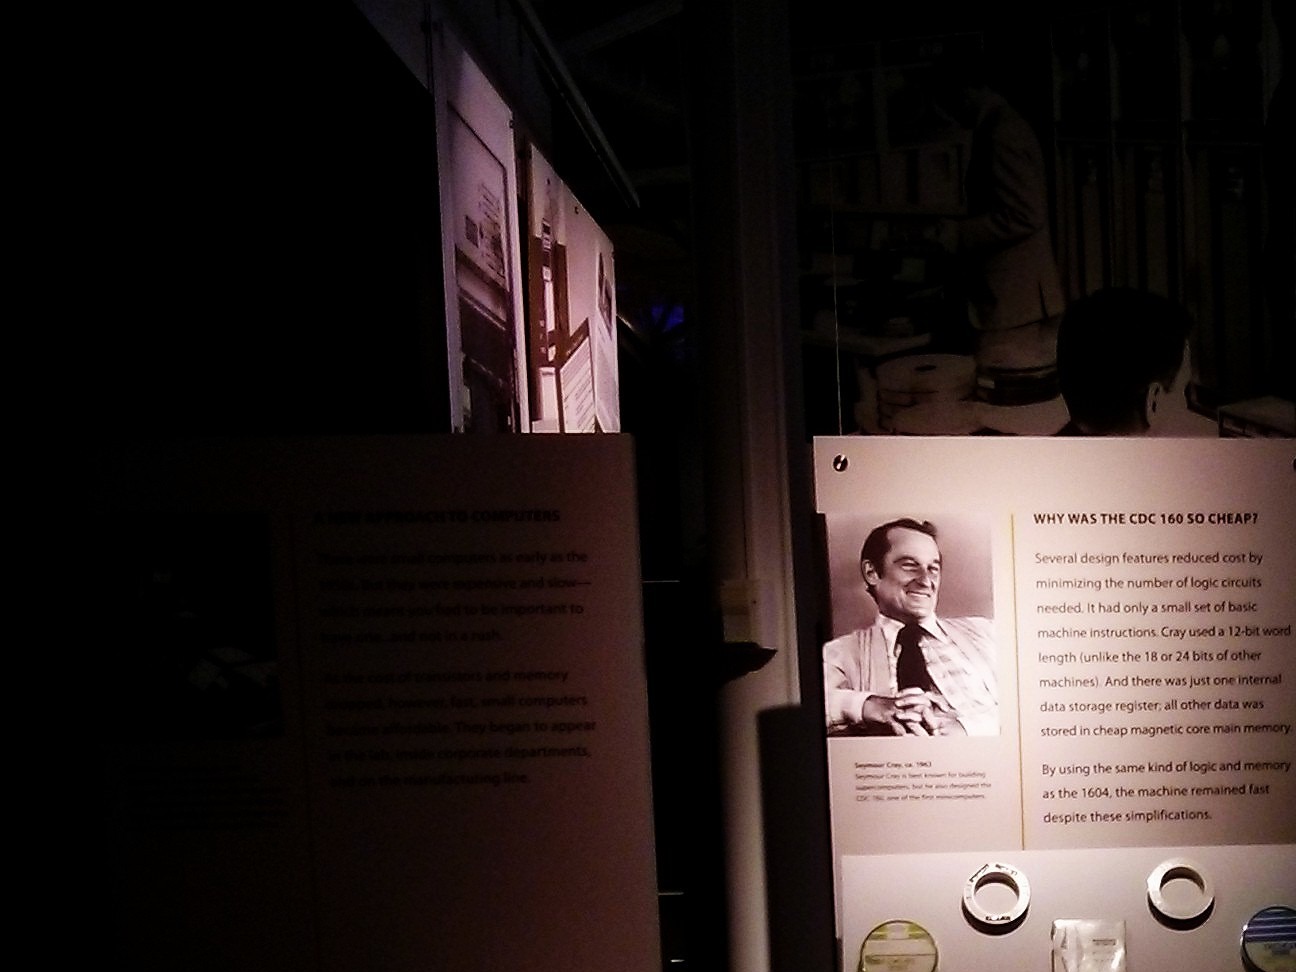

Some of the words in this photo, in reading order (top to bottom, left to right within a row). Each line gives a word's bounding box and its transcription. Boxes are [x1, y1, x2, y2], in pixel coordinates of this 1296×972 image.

[1032, 512, 1066, 525] WHY
[1067, 512, 1098, 526] WAS
[1099, 512, 1127, 526] THE
[1128, 512, 1157, 526] CDC
[1159, 512, 1185, 526] 160
[1186, 512, 1206, 525] SO
[1207, 512, 1259, 526] CHEAP?
[1034, 551, 1078, 565] Several
[1079, 551, 1121, 568] design
[1121, 551, 1171, 565] features
[1171, 550, 1221, 565] reduced
[1221, 552, 1247, 564] cost
[1248, 550, 1264, 567] by
[1035, 577, 1103, 592] minimizing
[1104, 576, 1125, 590] the
[1126, 576, 1175, 590] number
[1175, 575, 1190, 589] of
[1189, 575, 1220, 592] logic
[1220, 576, 1263, 589] circuits
[1086, 602, 1096, 615] It
[1097, 600, 1121, 614] had
[1122, 600, 1150, 617] only
[1150, 603, 1159, 614] a
[1160, 600, 1192, 614] small
[1193, 601, 1212, 614] set
[1212, 599, 1227, 614] of
[1227, 599, 1258, 613] basic
[1036, 626, 1088, 640] machine
[1159, 625, 1188, 641] Cray
[1187, 625, 1217, 638] used
[1217, 627, 1226, 638] a
[1261, 623, 1292, 637] word
[1038, 651, 1078, 667] length
[1078, 650, 1120, 664] (unlike
[1121, 650, 1142, 663] the
[1144, 650, 1159, 663] 18
[1159, 652, 1174, 663] or
[1175, 649, 1191, 663] 24
[1191, 649, 1215, 663] bits
[1215, 648, 1230, 662] of
[1229, 648, 1263, 662] other
[1103, 674, 1130, 688] And
[1130, 674, 1163, 688] there
[1163, 676, 1188, 687] was
[1188, 674, 1211, 690] just
[1212, 676, 1237, 687] one
[1237, 673, 1283, 686] internal
[1039, 700, 1067, 713] data
[1068, 701, 1113, 716] storage
[1163, 698, 1179, 712] all
[1179, 698, 1213, 712] other
[1213, 697, 1240, 711] data
[1241, 700, 1265, 710] was
[1040, 724, 1078, 738] stored
[1079, 725, 1092, 737] in
[1092, 724, 1129, 739] cheap
[1129, 723, 1184, 739] magnetic
[1185, 724, 1212, 735] core
[1212, 724, 1242, 735] main
[1041, 763, 1057, 778] By
[1058, 763, 1091, 778] using
[1092, 761, 1113, 775] the
[1114, 763, 1146, 775] same
[1147, 760, 1174, 774] kind
[1174, 760, 1189, 773] of
[1188, 760, 1218, 776] logic
[1218, 759, 1242, 772] and
[1243, 762, 1292, 775] memory
[1041, 789, 1056, 800] as
[1057, 786, 1079, 800] the
[1114, 785, 1136, 799] the
[1136, 784, 1189, 798] machine
[1190, 783, 1247, 797] remained
[1248, 782, 1270, 795] fast
[1042, 811, 1088, 826] despite
[1089, 810, 1123, 823] these
